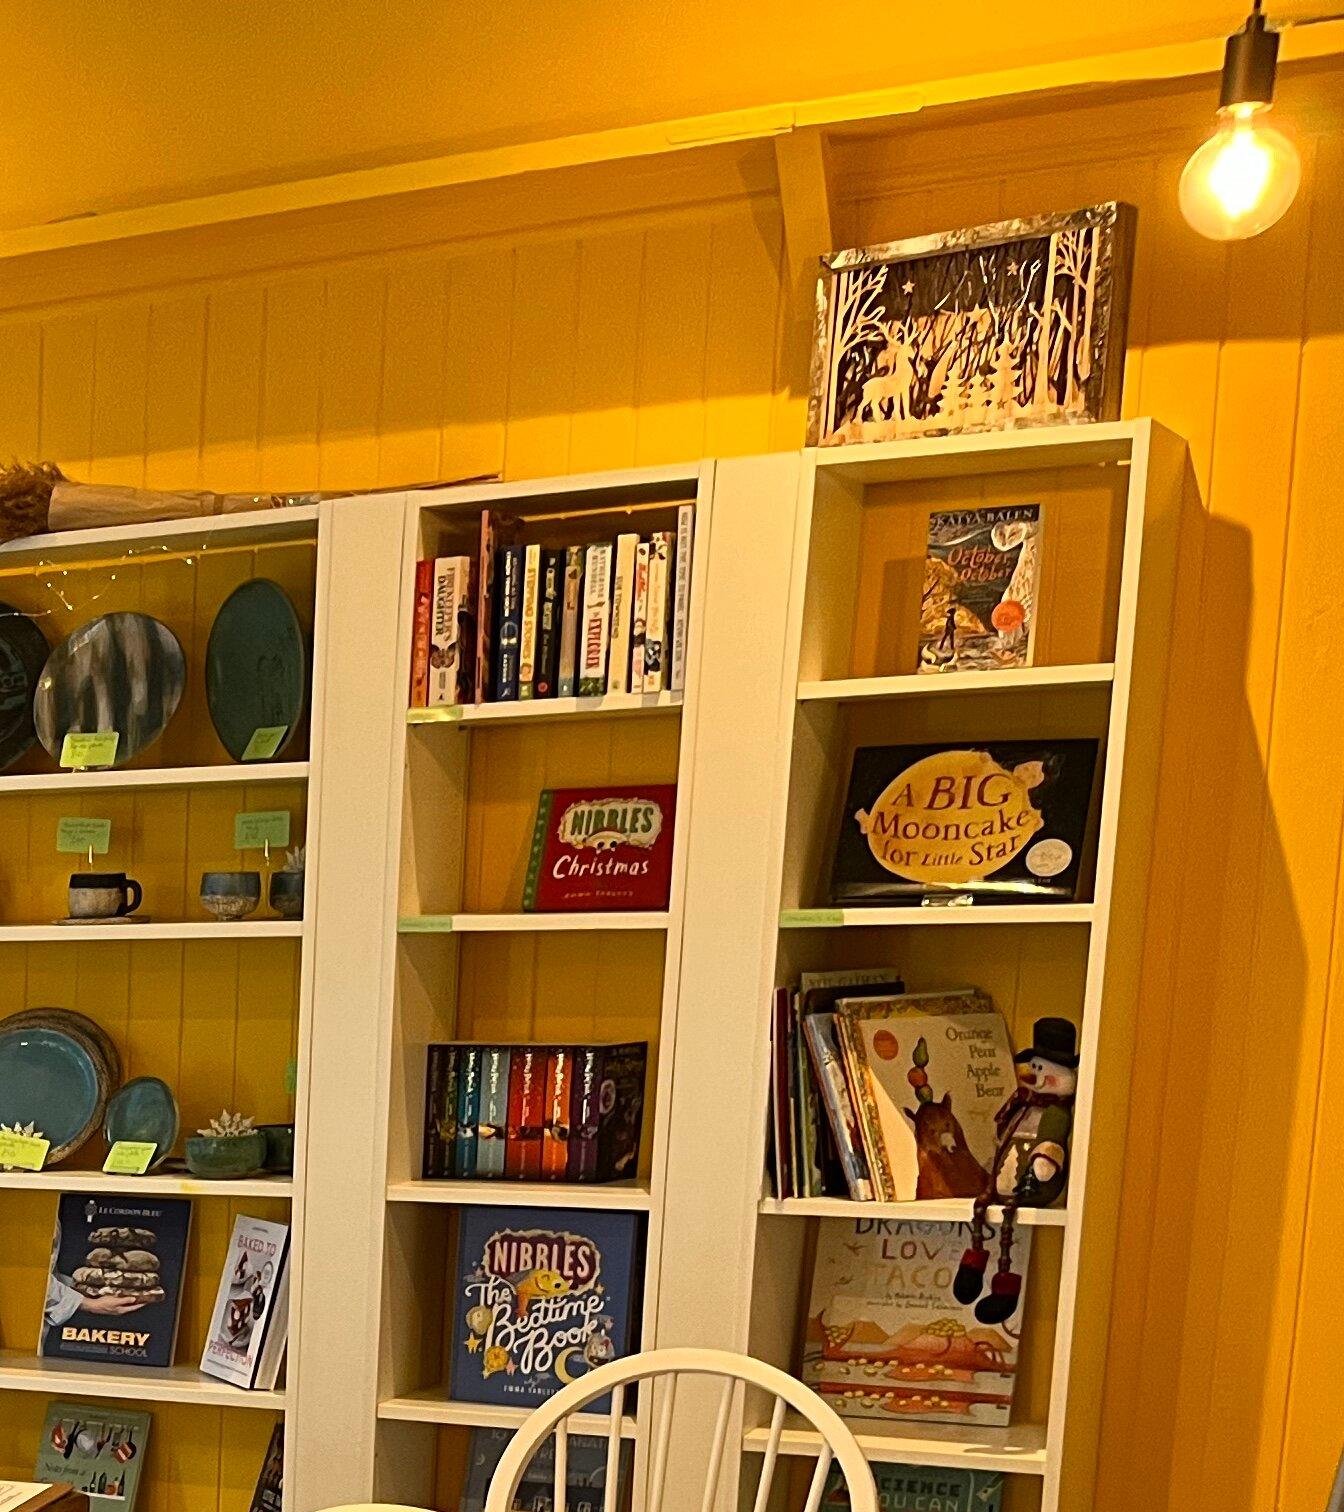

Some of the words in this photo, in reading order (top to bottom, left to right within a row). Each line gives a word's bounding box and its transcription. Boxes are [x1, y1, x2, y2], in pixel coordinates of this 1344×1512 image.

[892, 783, 914, 807] A
[924, 773, 1012, 811] BIG
[571, 807, 653, 835] NIBBLES
[872, 809, 1031, 842] Mooncake
[881, 840, 920, 866] for
[968, 834, 1021, 866] Star
[553, 855, 649, 879] Christmas
[238, 1235, 264, 1253] BAKED
[265, 1240, 277, 1257] TO
[494, 1241, 591, 1277] NIBBLES
[465, 1275, 512, 1306] The
[865, 1264, 952, 1289] TACO
[62, 1327, 150, 1346] BAKERY
[486, 1295, 604, 1353] Bedtime
[513, 1320, 598, 1374] Book
[879, 1477, 962, 1496] CIENCE
[879, 1495, 907, 1509] OU
[915, 1497, 960, 1512] CAN
